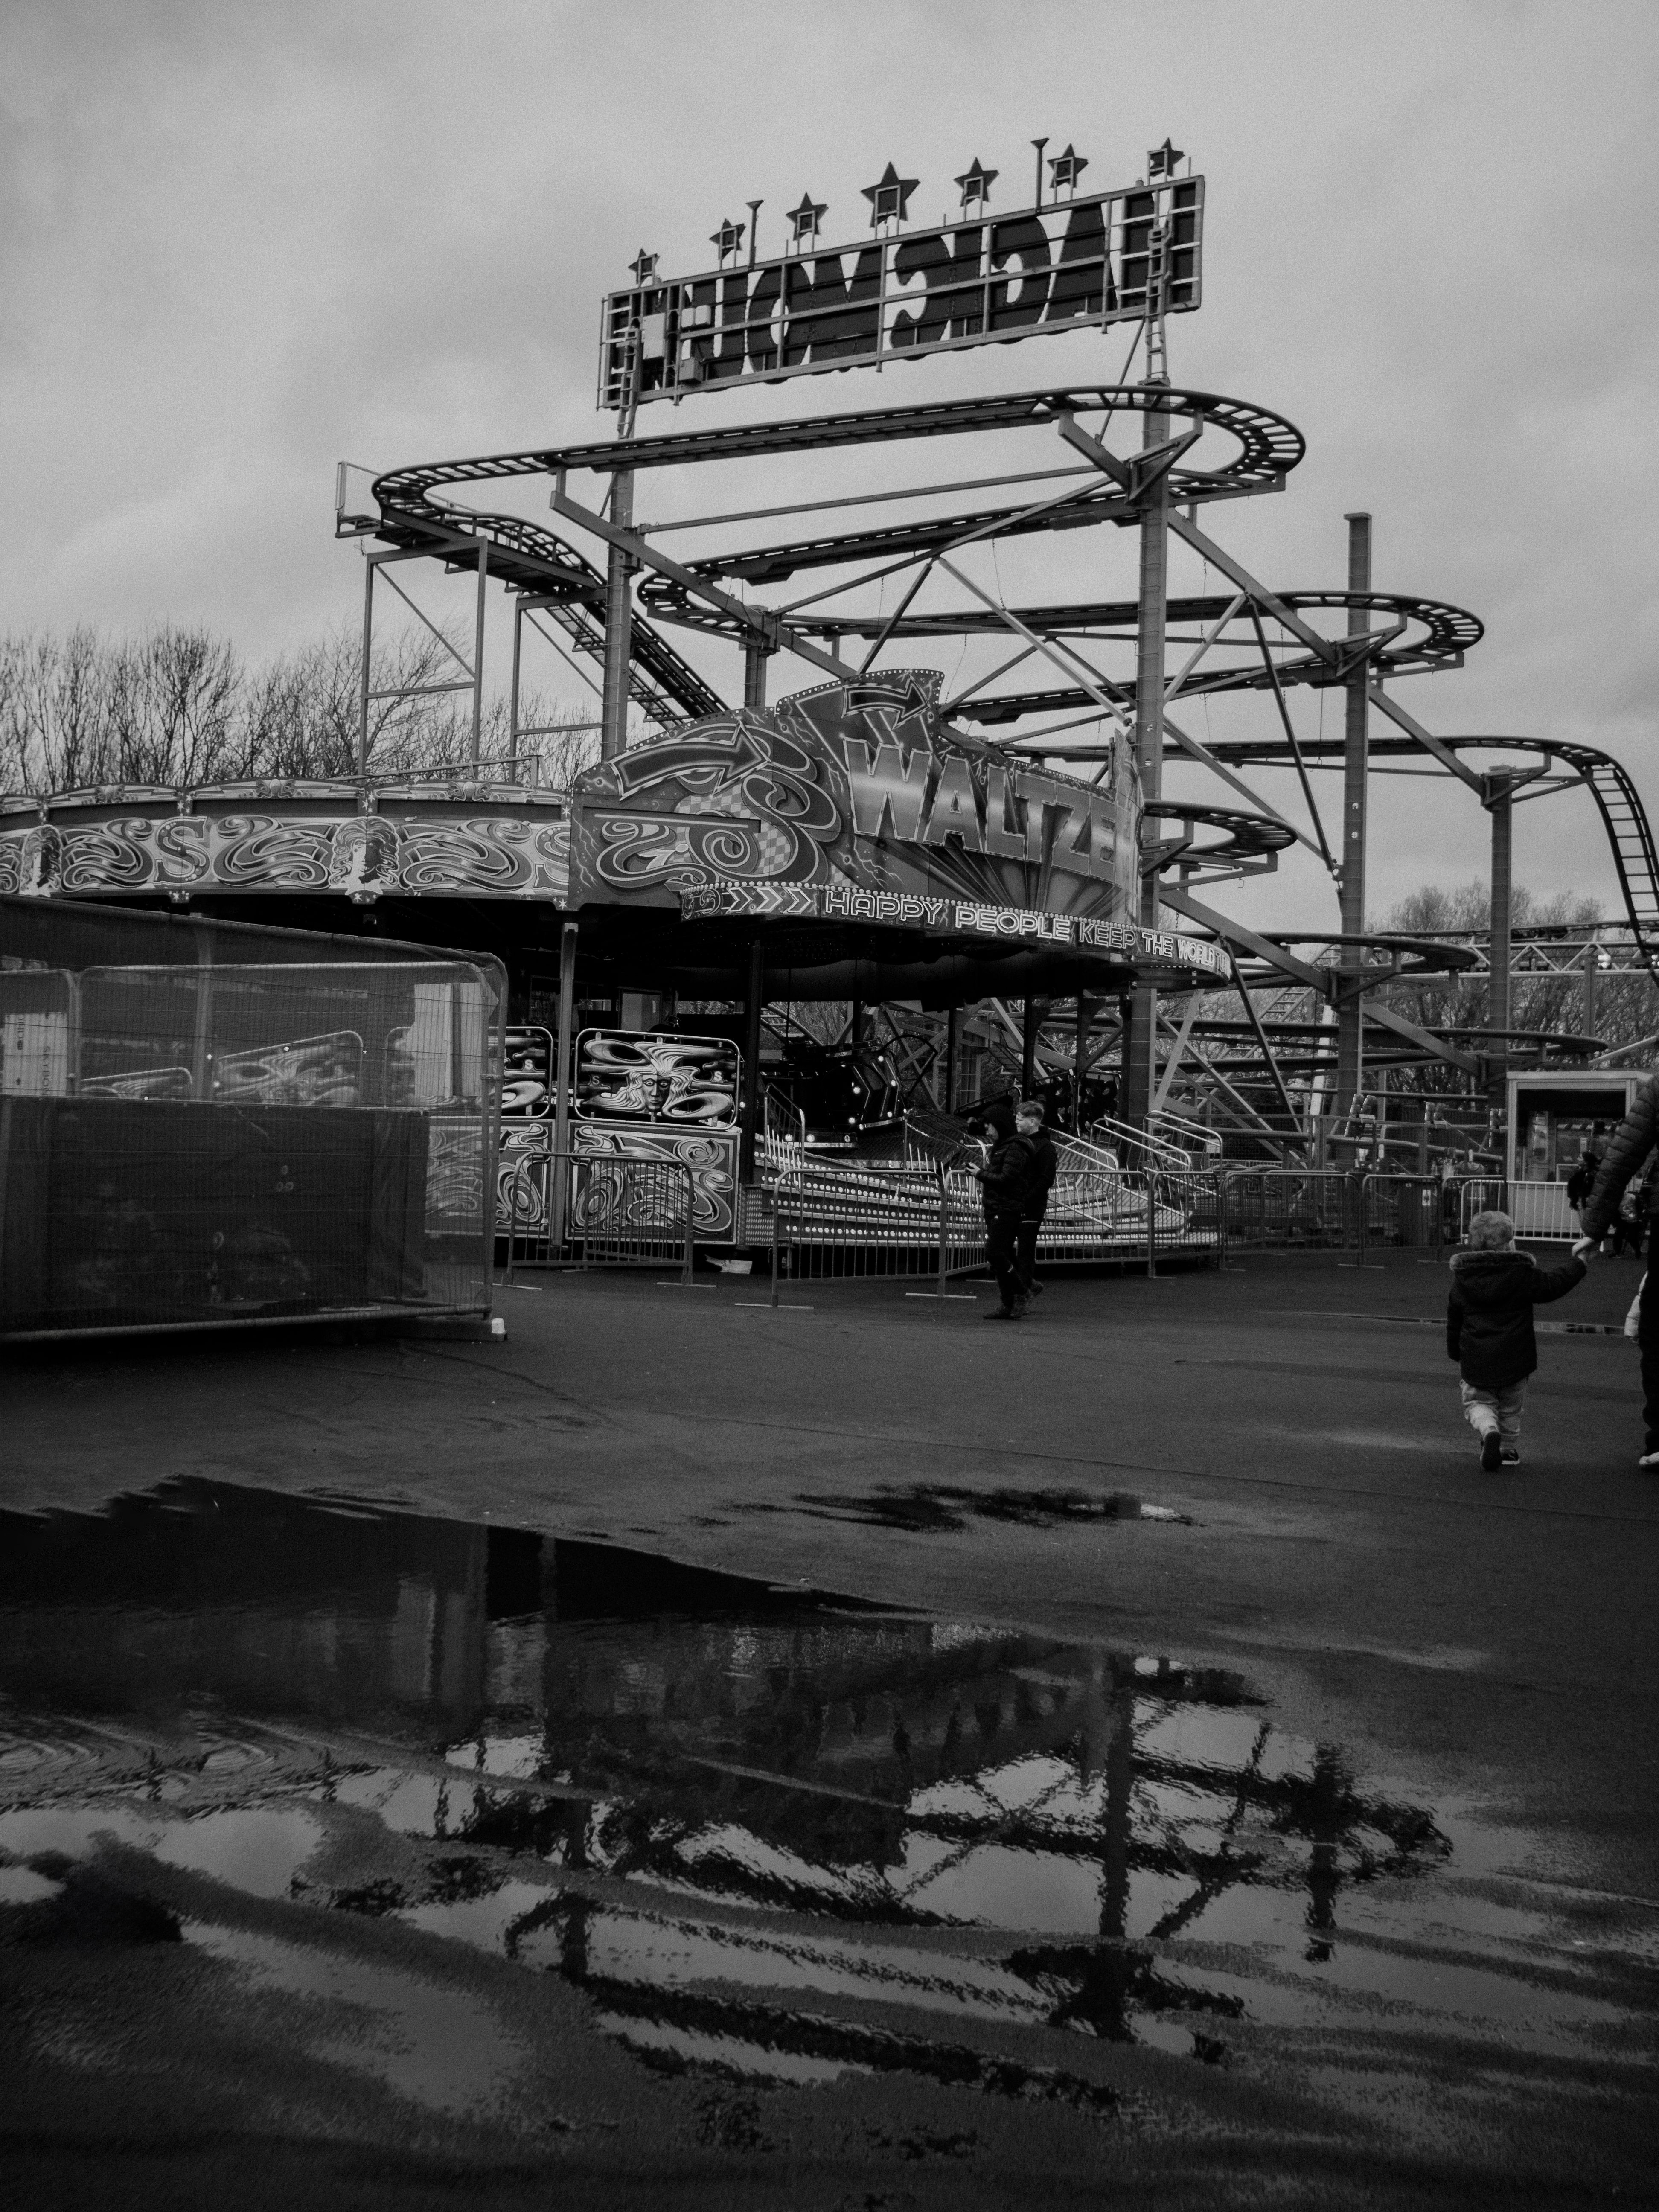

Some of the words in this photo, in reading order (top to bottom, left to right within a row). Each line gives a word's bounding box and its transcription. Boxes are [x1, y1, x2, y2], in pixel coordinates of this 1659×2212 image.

[825, 891, 943, 925] HAPPY
[955, 905, 1071, 941] PEOPLE
[1079, 922, 1136, 949] KEEP
[1142, 932, 1173, 958] THE
[1178, 939, 1215, 967] WORLD
